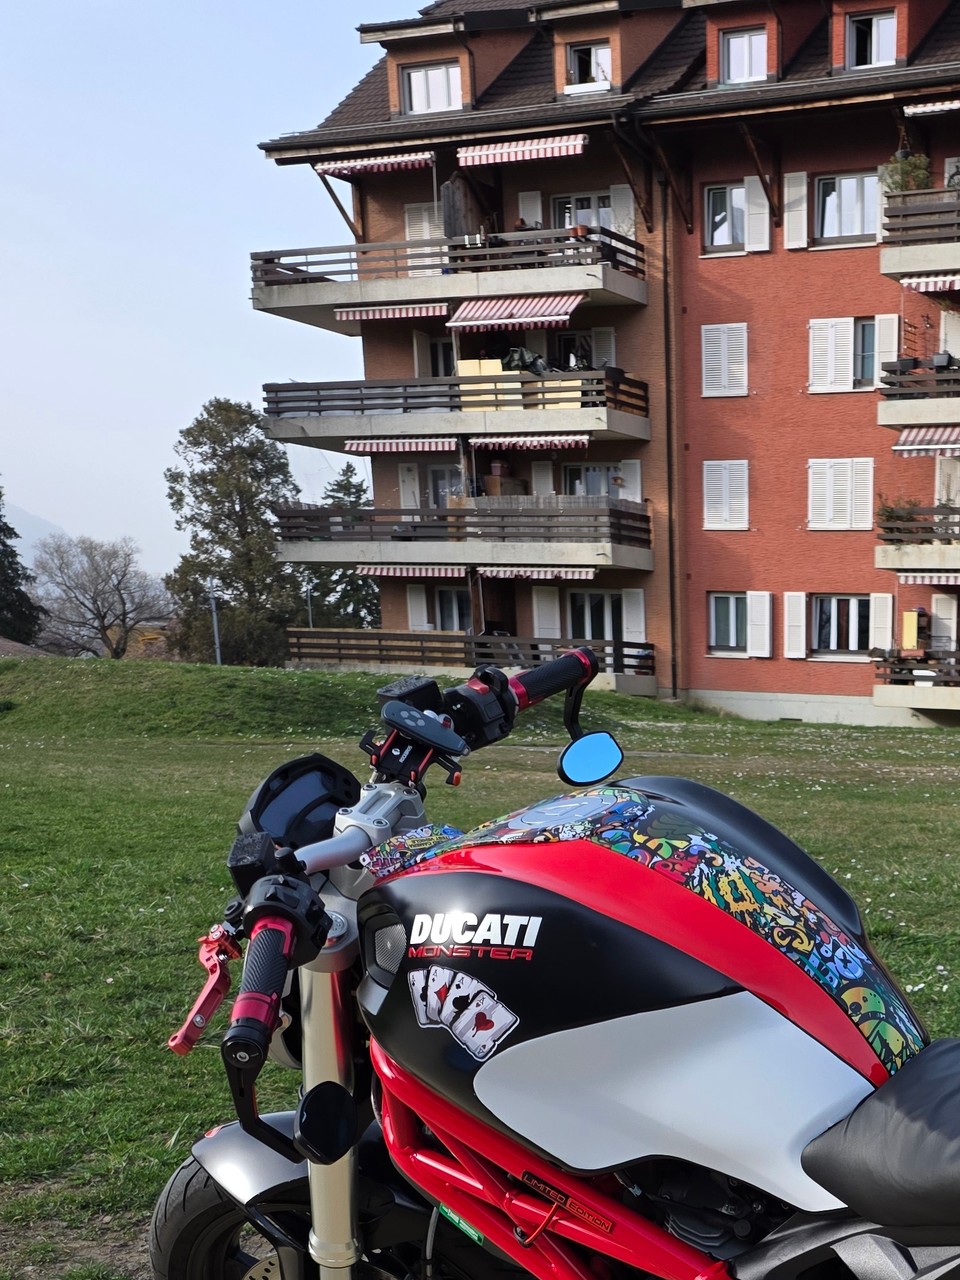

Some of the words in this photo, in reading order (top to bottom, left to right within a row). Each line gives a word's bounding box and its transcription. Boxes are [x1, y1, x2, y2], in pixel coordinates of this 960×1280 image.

[410, 912, 542, 947] DUCATI
[408, 945, 534, 961] MONSTER
[523, 1174, 566, 1203] LIMITED
[569, 1202, 610, 1232] EDITION
